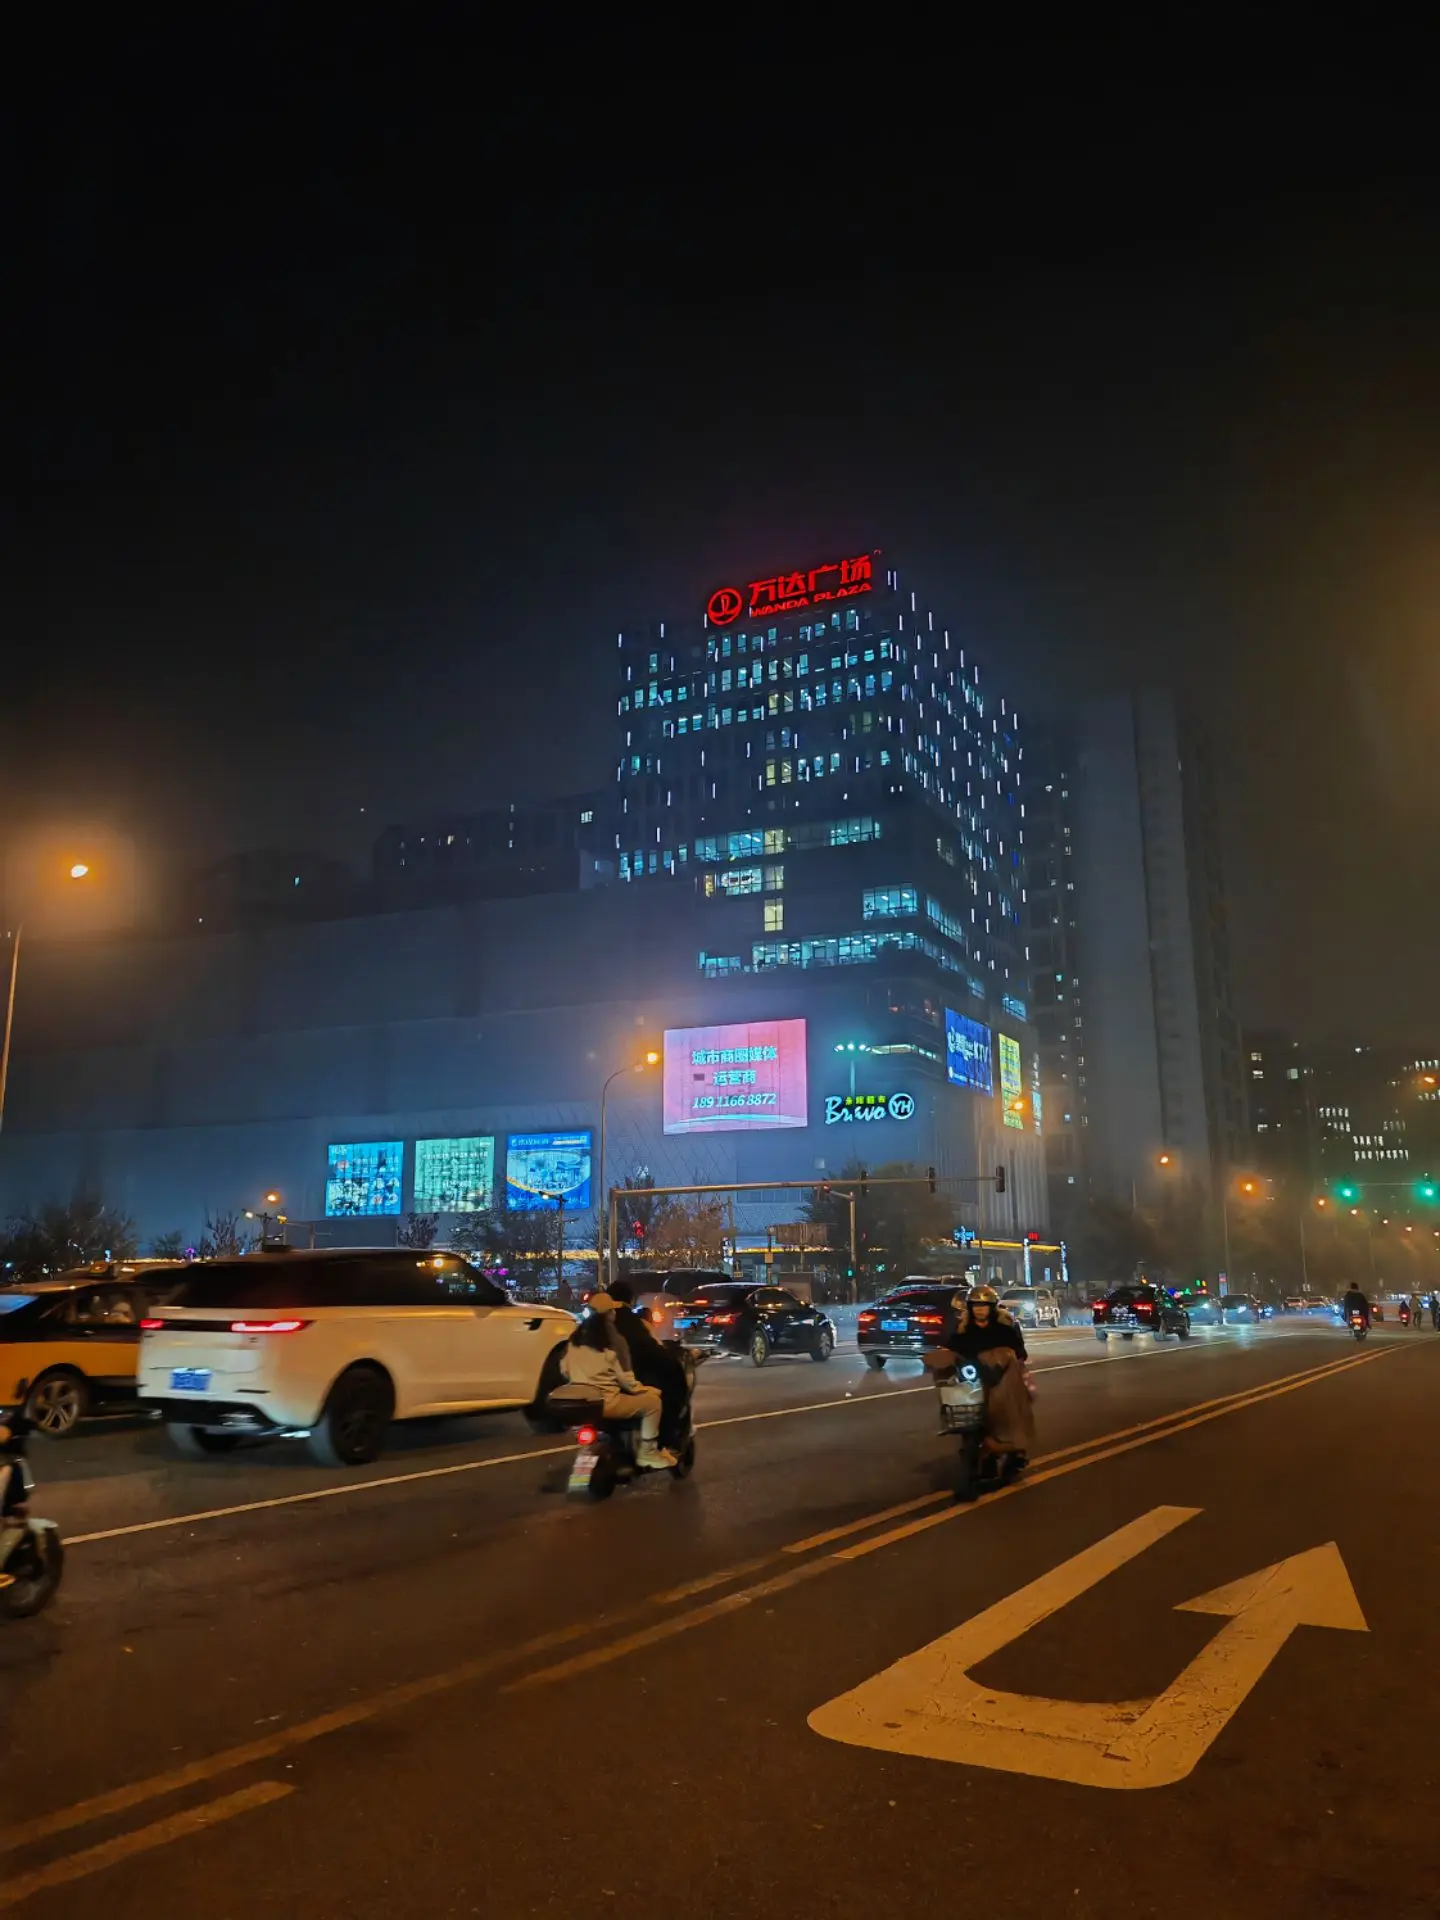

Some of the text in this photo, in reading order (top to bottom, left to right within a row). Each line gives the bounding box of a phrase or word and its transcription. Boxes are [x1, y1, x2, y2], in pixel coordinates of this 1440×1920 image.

[748, 554, 872, 606] 万达广场
[752, 583, 872, 617] WANDA PLAZA
[713, 1069, 757, 1086] 运营商
[824, 1095, 887, 1125] Bravo
